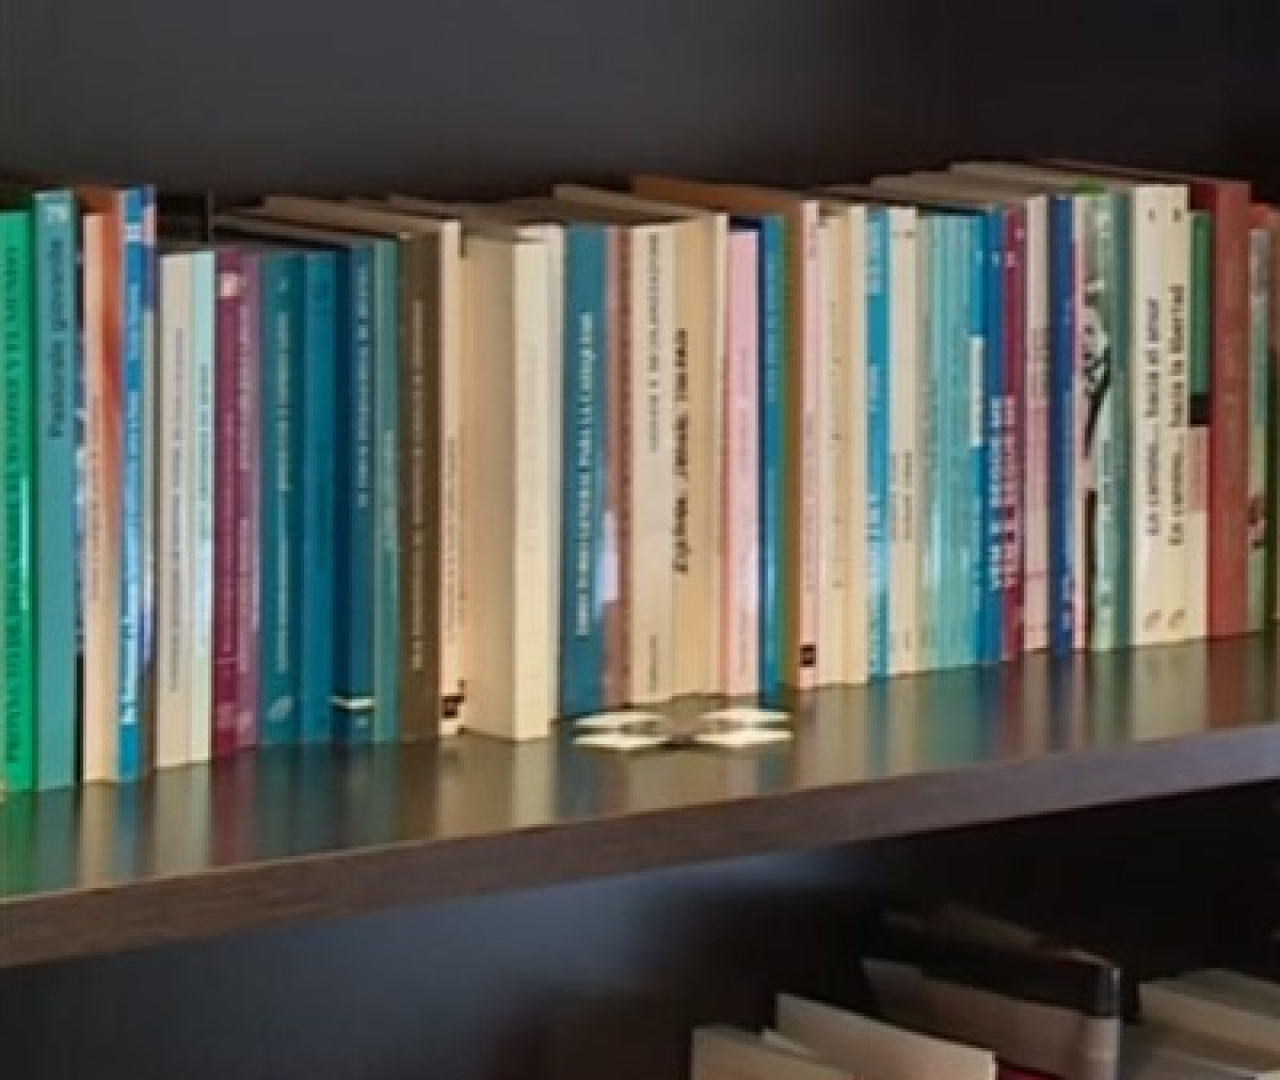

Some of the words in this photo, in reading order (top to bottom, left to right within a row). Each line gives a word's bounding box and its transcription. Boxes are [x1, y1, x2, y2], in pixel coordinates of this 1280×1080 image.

[1167, 284, 1184, 354] libertad
[1167, 359, 1184, 377] la
[1144, 370, 1160, 419] hacia
[1167, 381, 1184, 428] hacia
[1167, 522, 1184, 547] En
